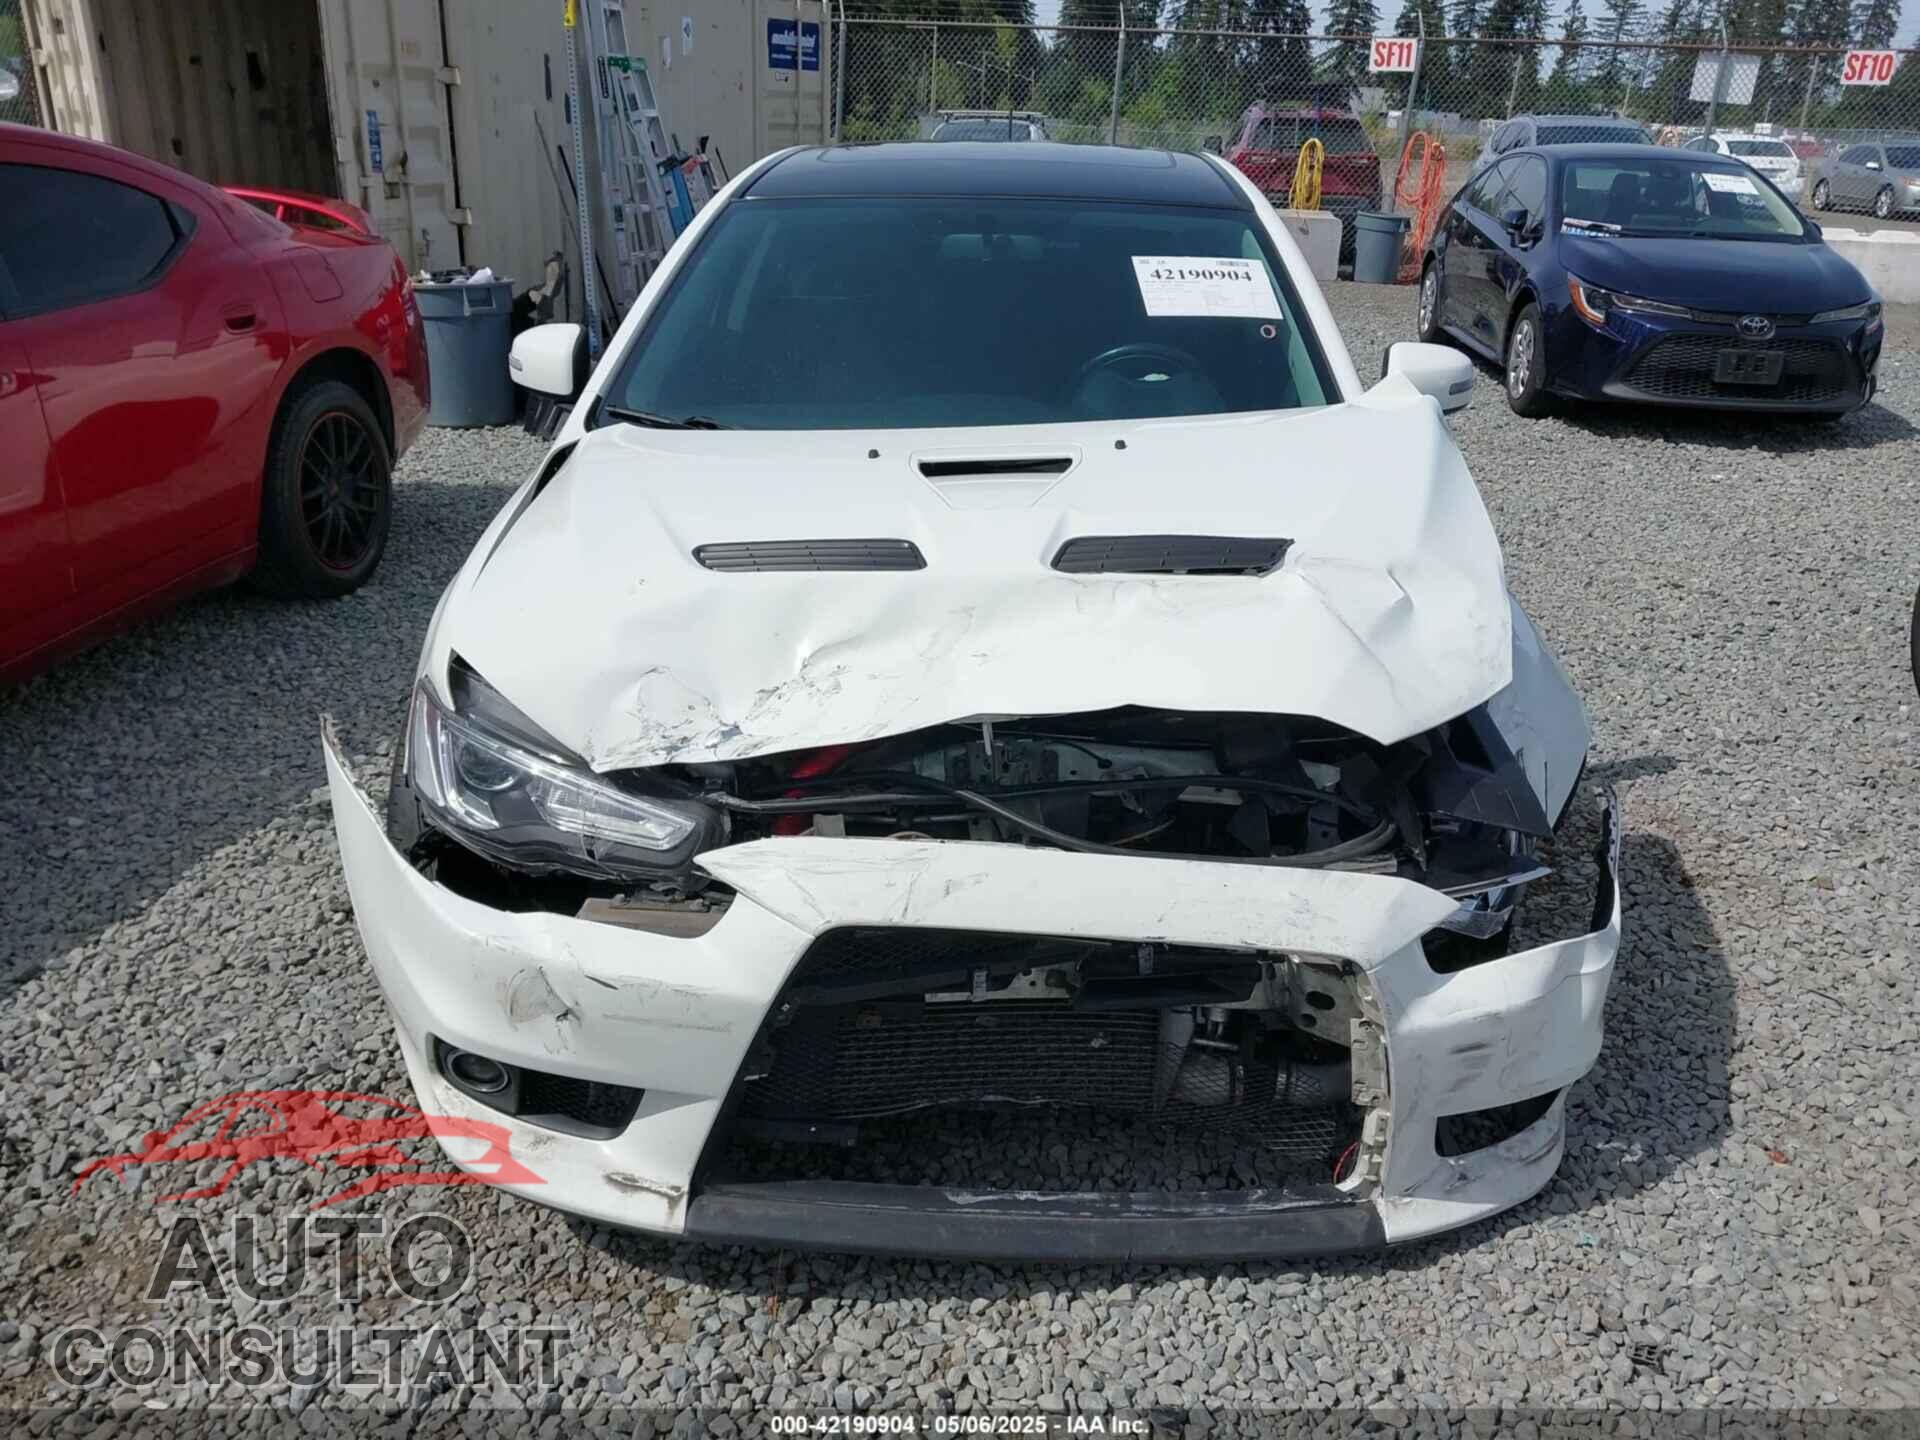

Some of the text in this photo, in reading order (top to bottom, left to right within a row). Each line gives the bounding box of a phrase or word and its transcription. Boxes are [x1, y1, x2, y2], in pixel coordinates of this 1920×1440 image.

[1374, 41, 1413, 68] SF11
[1844, 54, 1893, 81] SF10
[1150, 268, 1253, 282] 42190904
